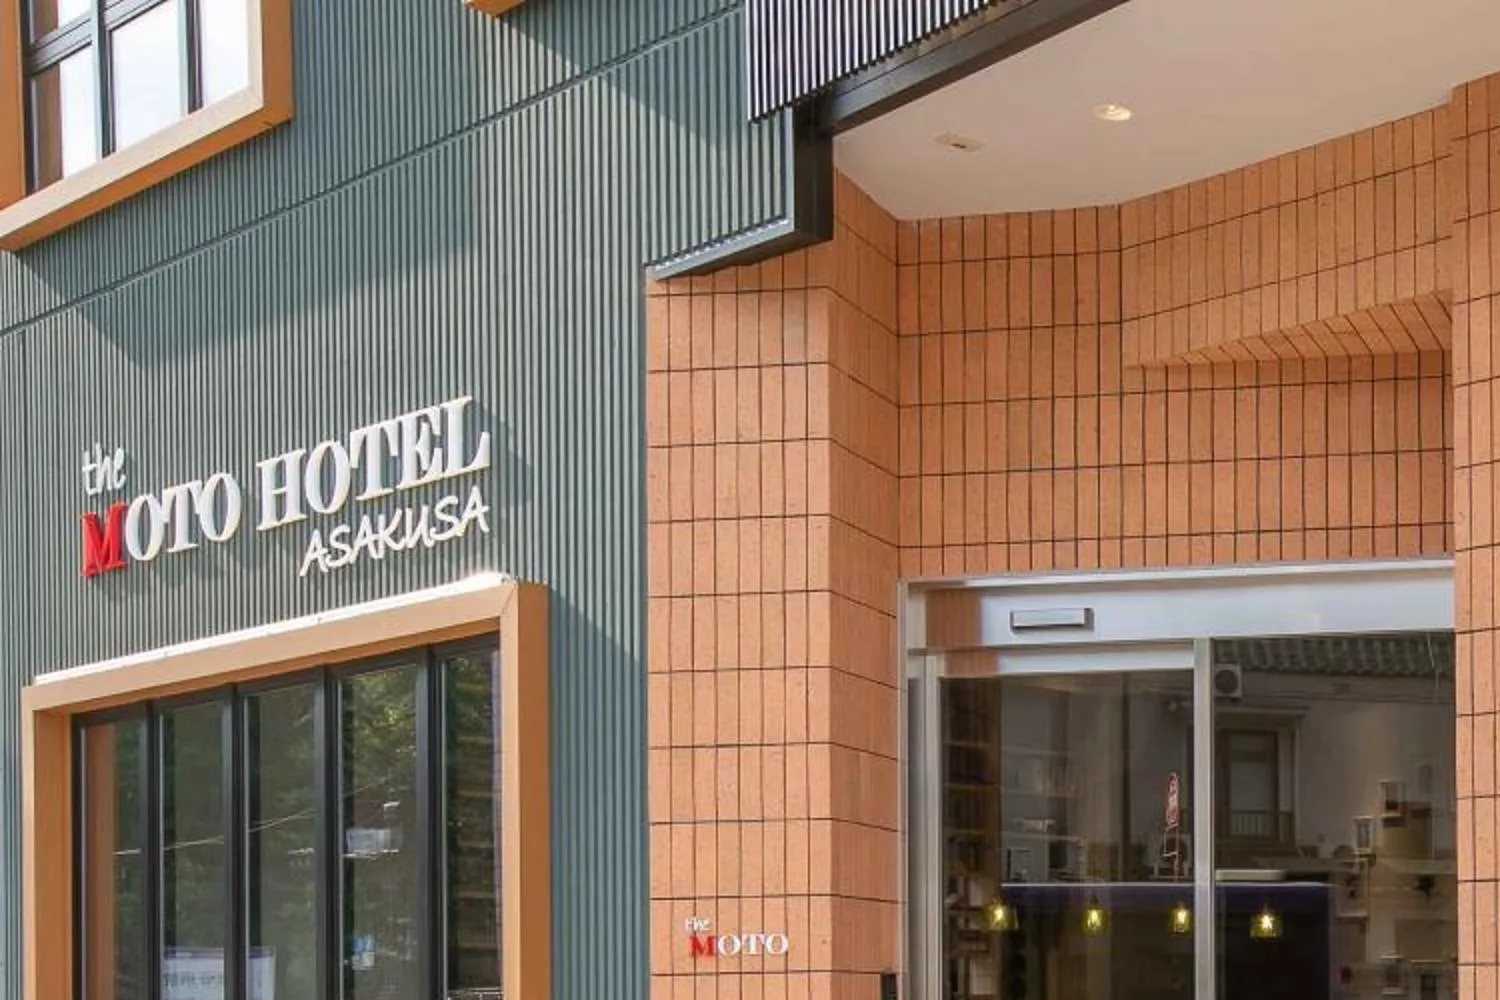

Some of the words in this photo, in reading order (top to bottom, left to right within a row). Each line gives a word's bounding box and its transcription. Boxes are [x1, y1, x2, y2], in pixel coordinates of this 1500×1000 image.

[81, 471, 241, 577] MOTO
[256, 396, 490, 531] HOTEL
[82, 443, 126, 495] the
[299, 485, 490, 576] ASAKUSA
[688, 932, 789, 958] MOTO
